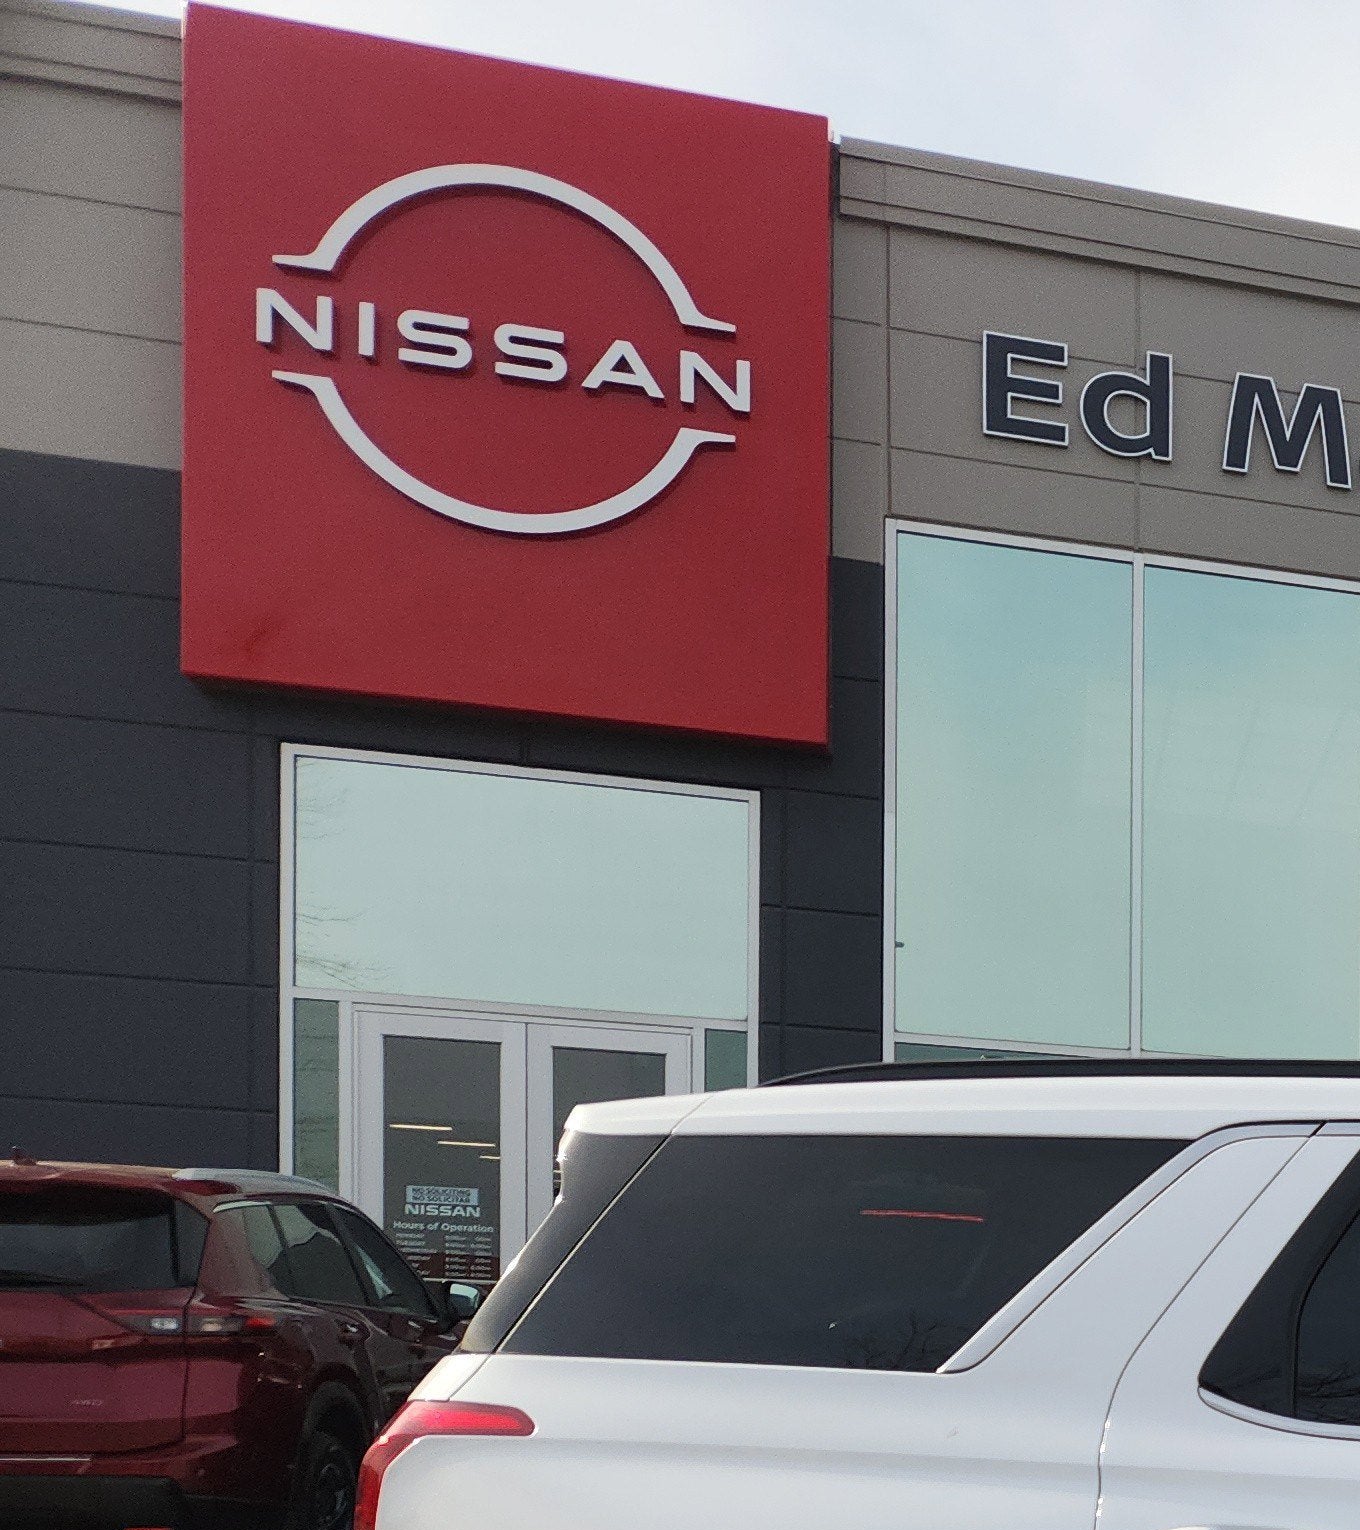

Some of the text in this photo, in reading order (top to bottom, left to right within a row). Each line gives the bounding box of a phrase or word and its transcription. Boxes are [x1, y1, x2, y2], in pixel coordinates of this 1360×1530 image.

[256, 287, 751, 412] NISSAN
[982, 330, 1174, 461] Ed
[392, 1220, 494, 1233] Hours of Operation
[404, 1203, 481, 1217] NISSAN
